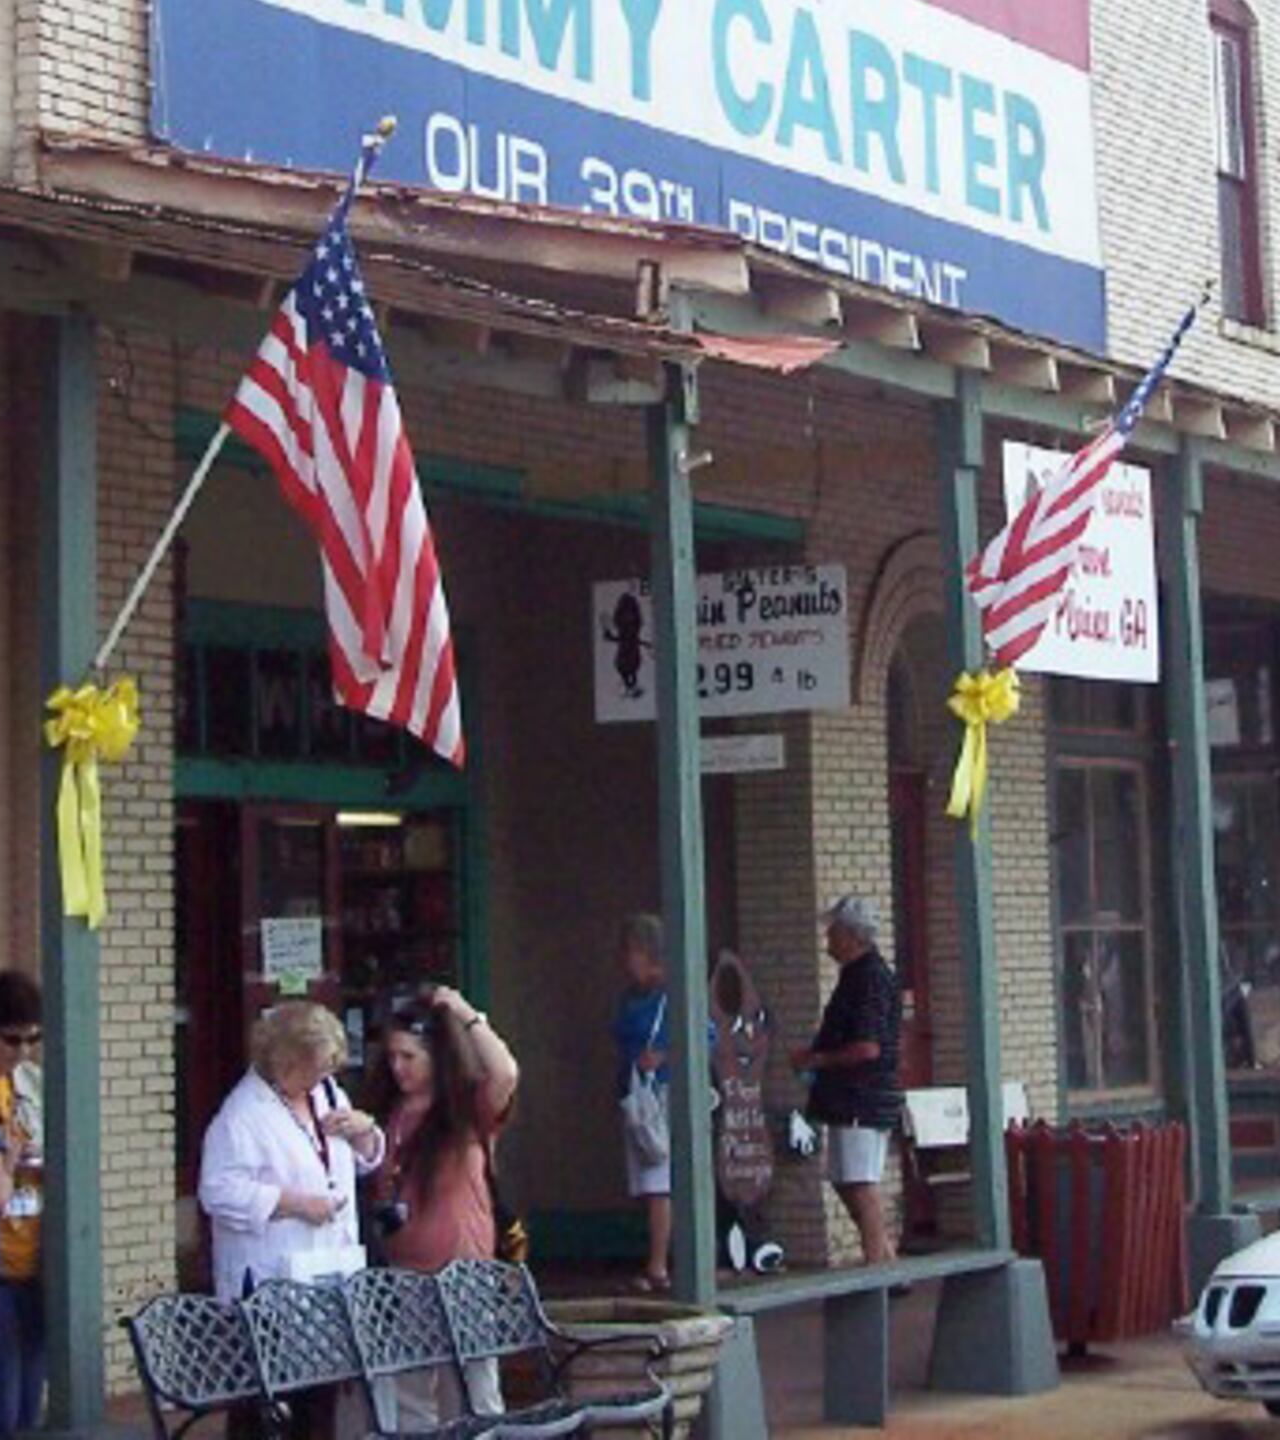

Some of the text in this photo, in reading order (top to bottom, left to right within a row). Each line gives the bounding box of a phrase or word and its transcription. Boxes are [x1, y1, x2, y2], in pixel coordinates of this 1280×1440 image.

[425, 113, 548, 205] OUR
[736, 580, 842, 624] Peanuts
[1119, 599, 1148, 650] GA
